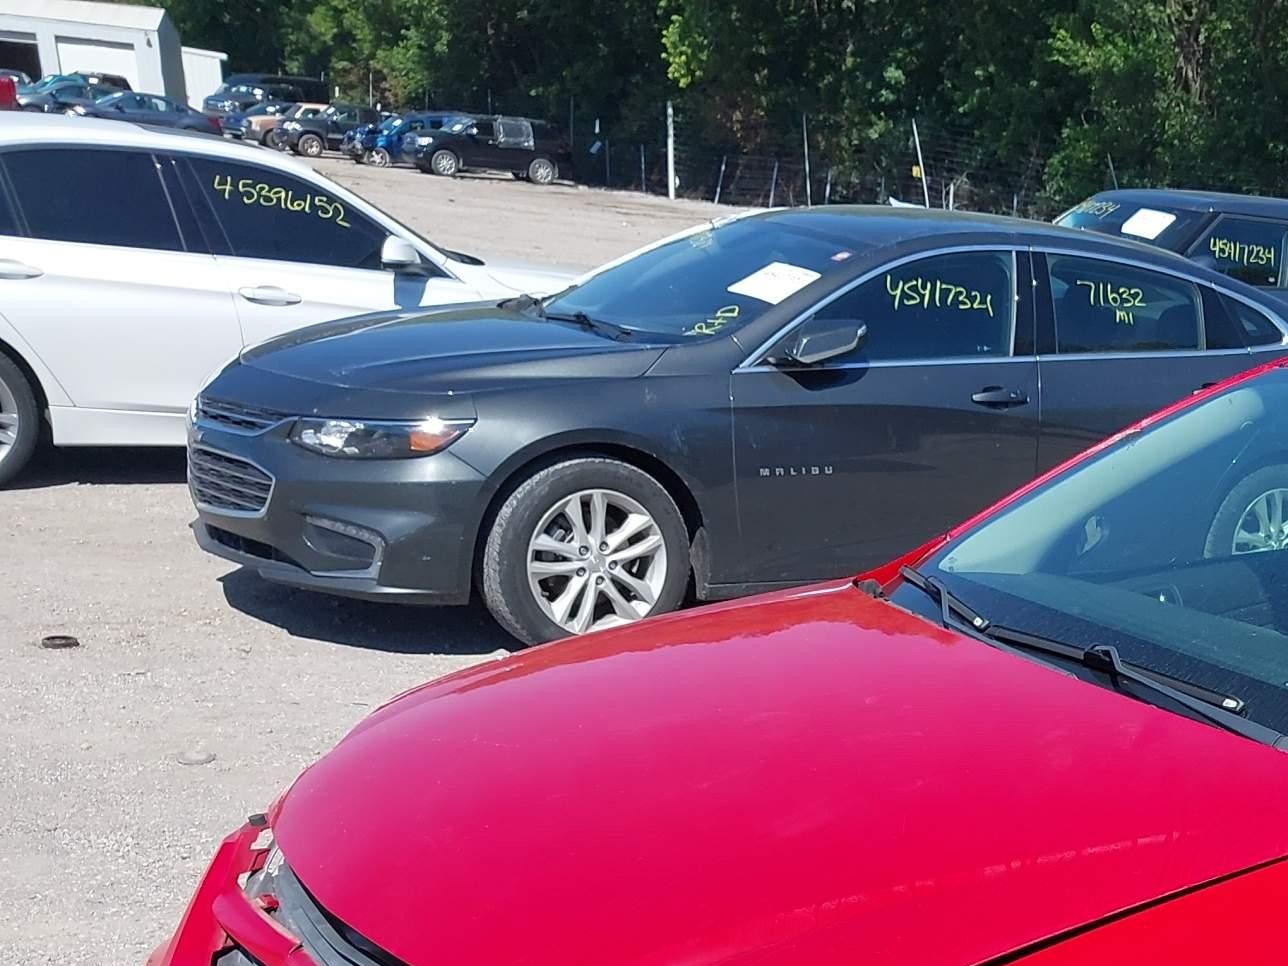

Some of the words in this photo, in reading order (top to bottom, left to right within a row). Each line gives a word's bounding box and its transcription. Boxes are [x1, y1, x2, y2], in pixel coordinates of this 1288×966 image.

[213, 174, 352, 228] 45396152
[1209, 237, 1275, 267] 45417234
[886, 273, 994, 317] 45417321
[1076, 279, 1148, 307] 71632
[759, 465, 833, 477] MALIBU
